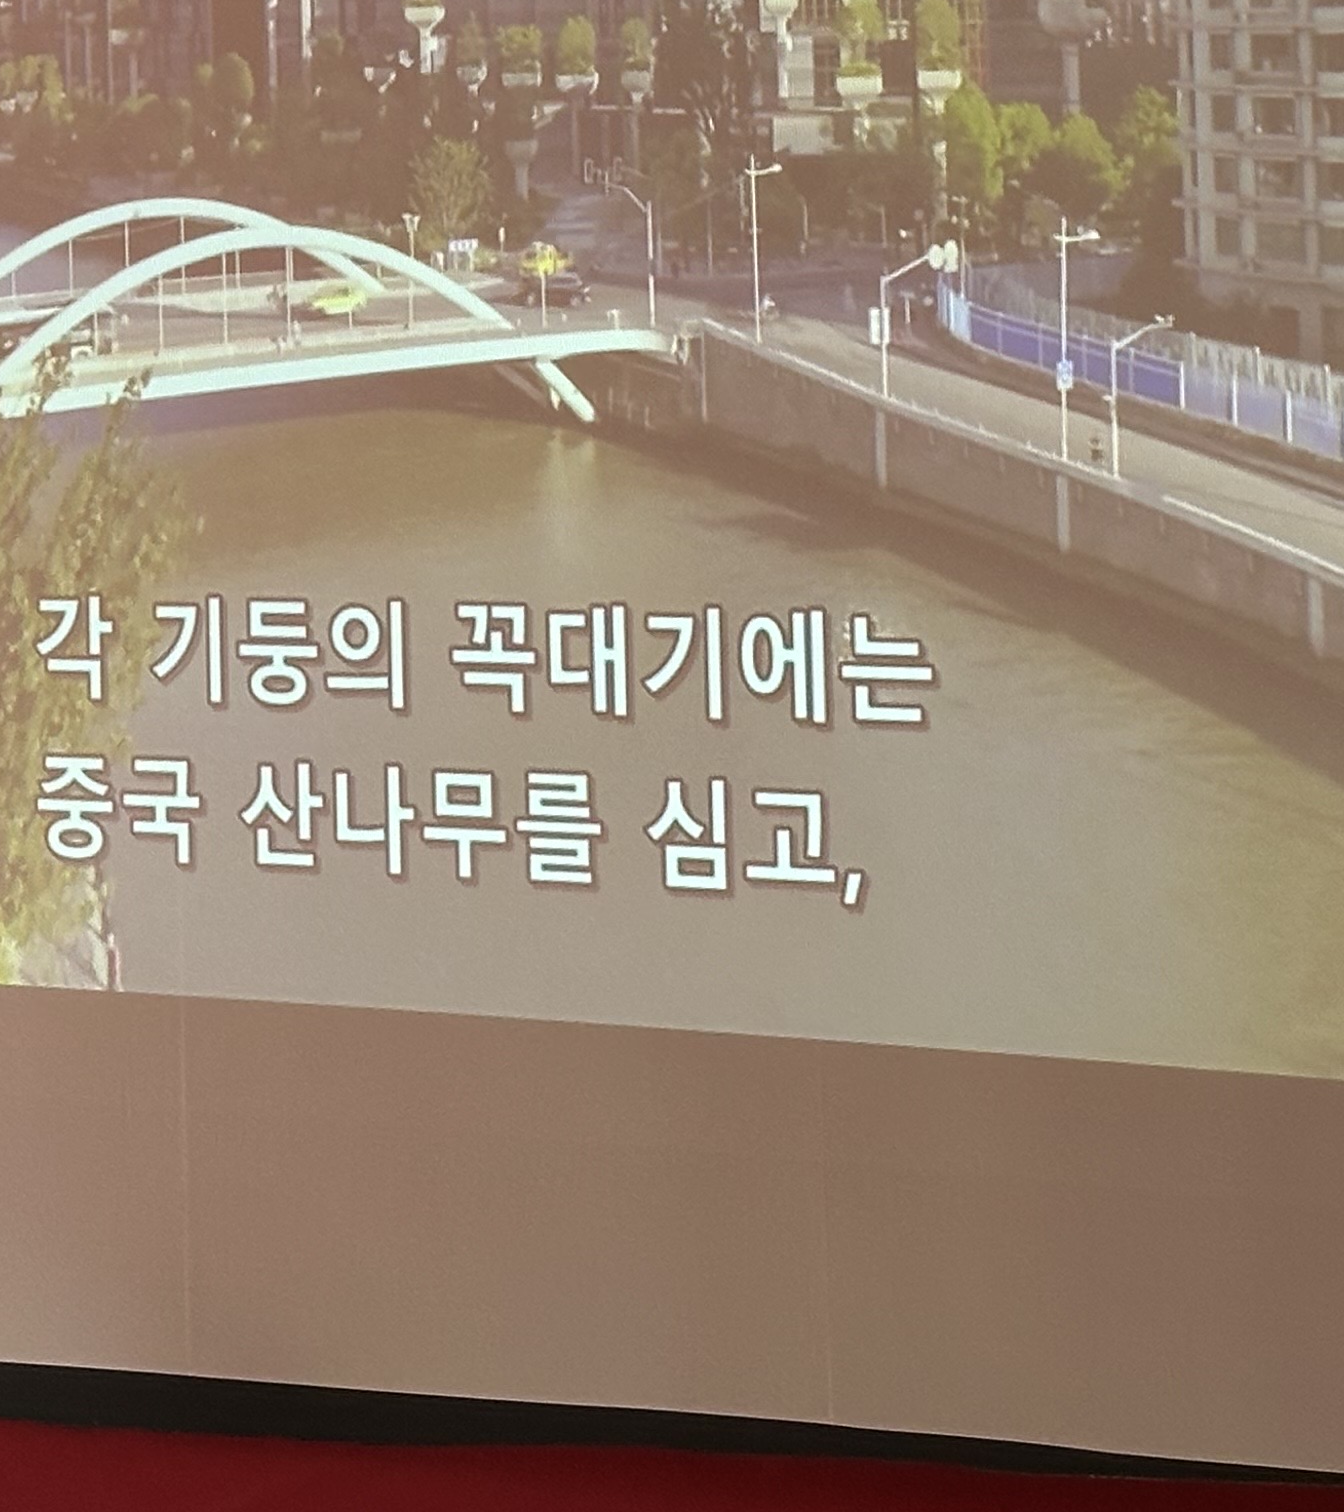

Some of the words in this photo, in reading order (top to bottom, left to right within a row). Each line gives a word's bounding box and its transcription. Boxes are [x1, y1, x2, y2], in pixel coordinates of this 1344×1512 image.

[36, 595, 113, 700] 각
[152, 597, 405, 709] 기둥의
[451, 603, 936, 724] 꼭대기에는
[36, 755, 201, 865] 중국
[239, 762, 602, 884] 산나무를
[647, 779, 864, 905] 심고,
